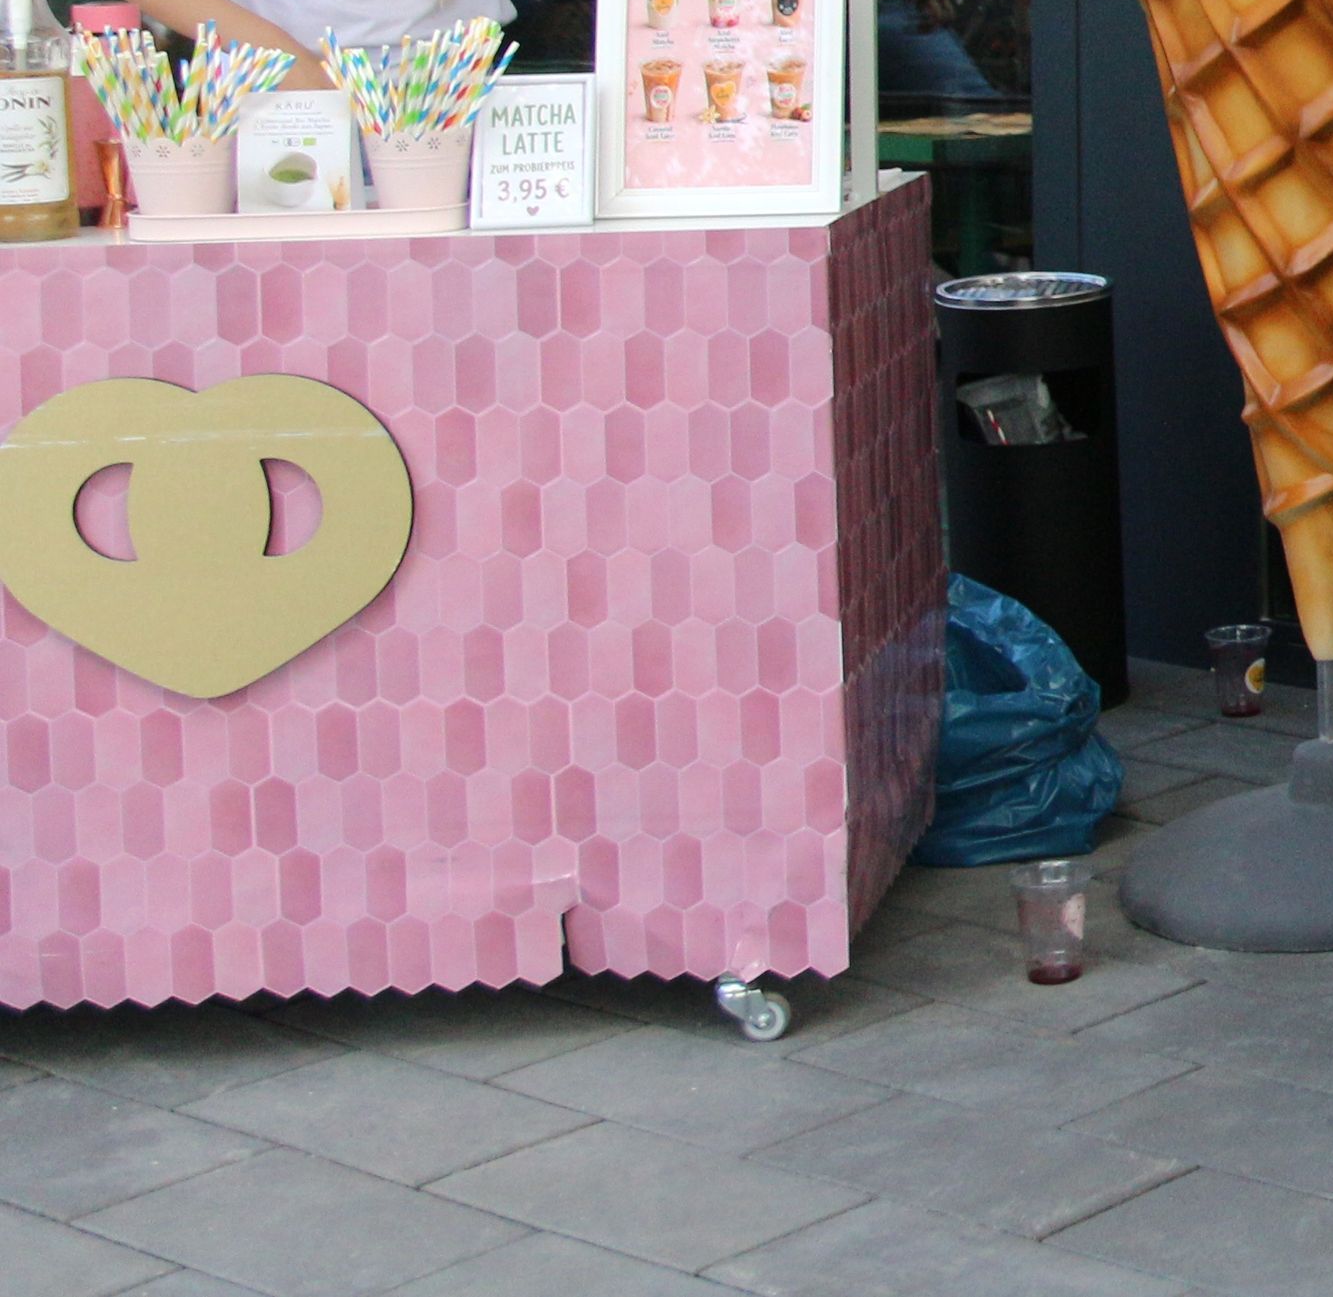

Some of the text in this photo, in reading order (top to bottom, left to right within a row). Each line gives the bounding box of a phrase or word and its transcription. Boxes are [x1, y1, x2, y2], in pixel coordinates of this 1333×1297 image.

[491, 103, 576, 128] MATCHA
[502, 131, 564, 155] LATTE
[490, 165, 509, 174] ZUM
[497, 177, 570, 202] 3,95 €
